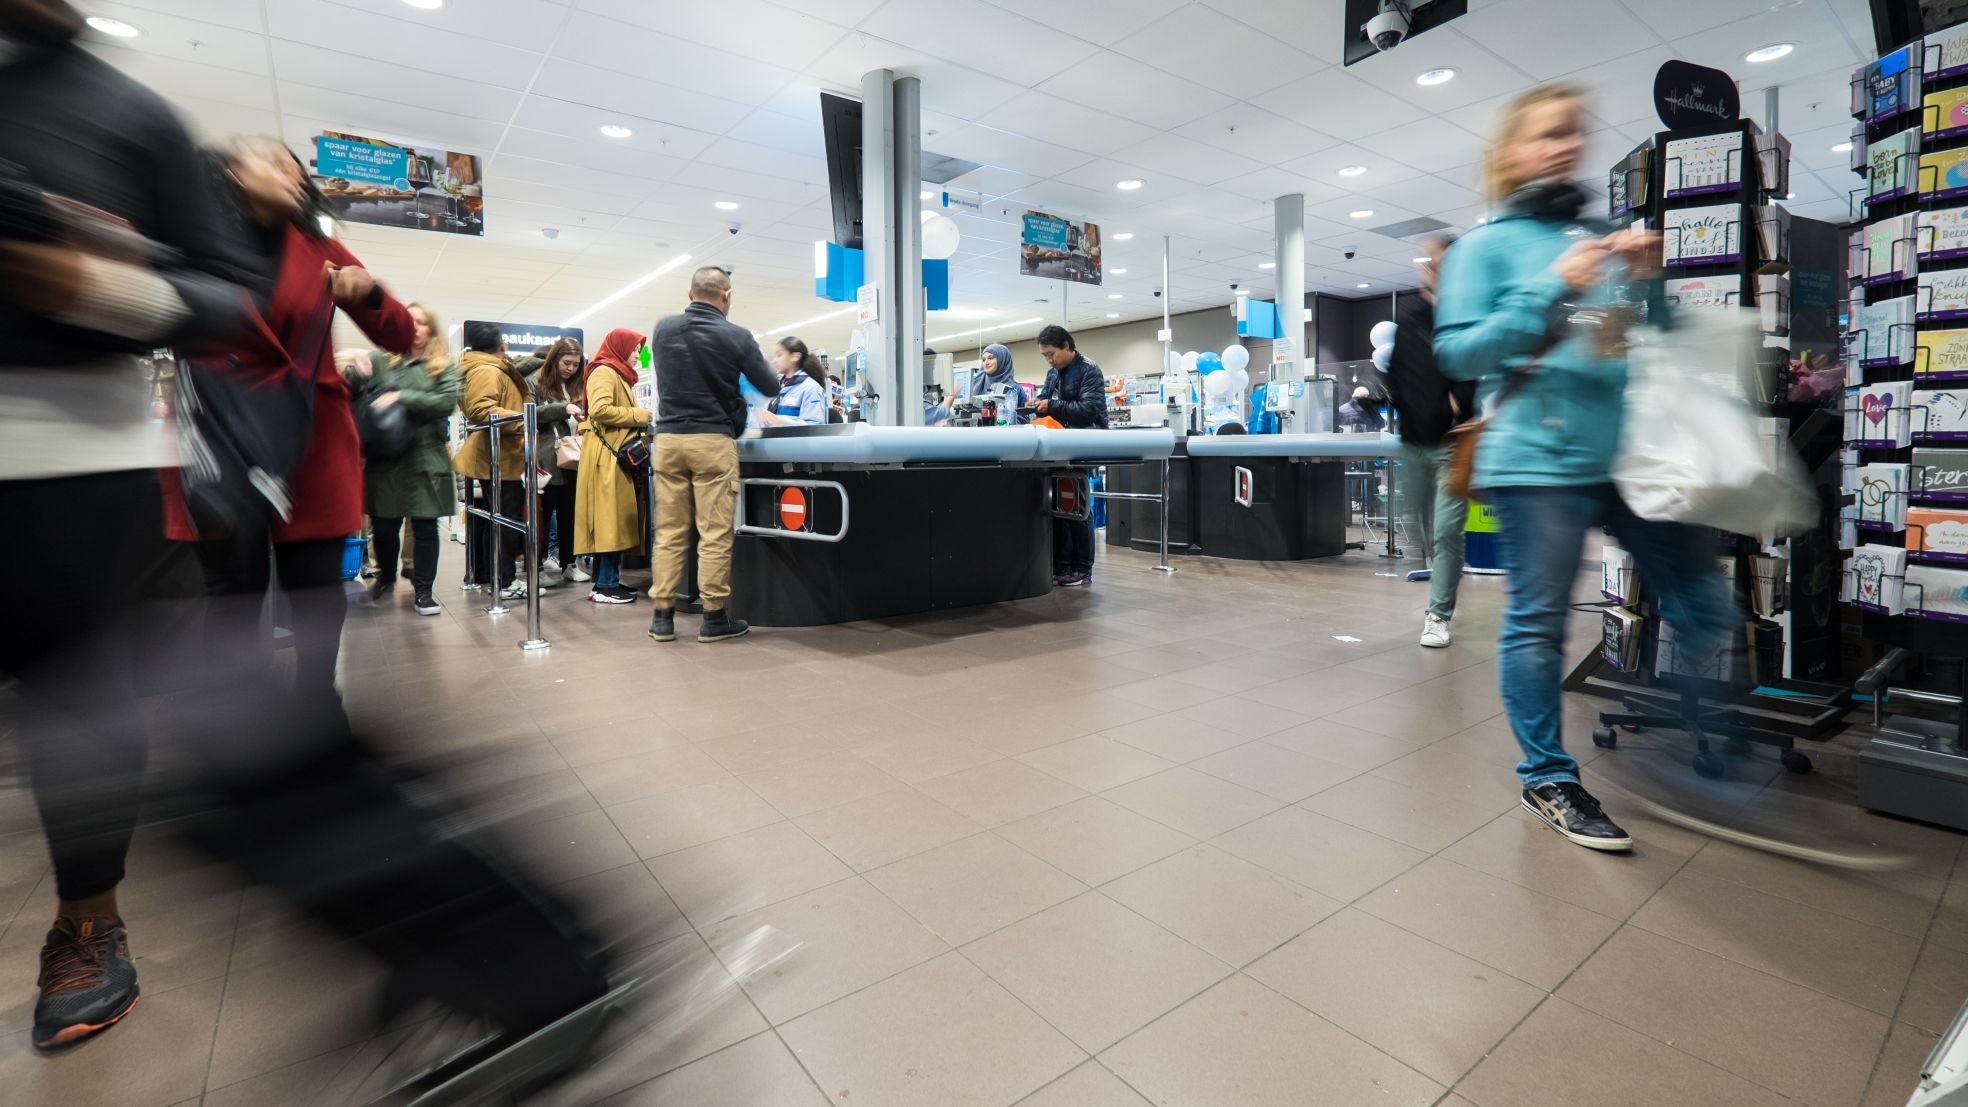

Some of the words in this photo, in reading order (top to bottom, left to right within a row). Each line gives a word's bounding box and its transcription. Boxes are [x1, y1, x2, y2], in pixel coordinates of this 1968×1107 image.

[1664, 87, 1731, 119] Hallmark
[324, 142, 349, 151] spaar
[352, 146, 371, 154] voor
[374, 149, 401, 159] glazen
[1873, 149, 1899, 164] born
[1681, 216, 1725, 231] hallo
[1865, 402, 1888, 413] Love
[1860, 563, 1878, 577] HAPPY
